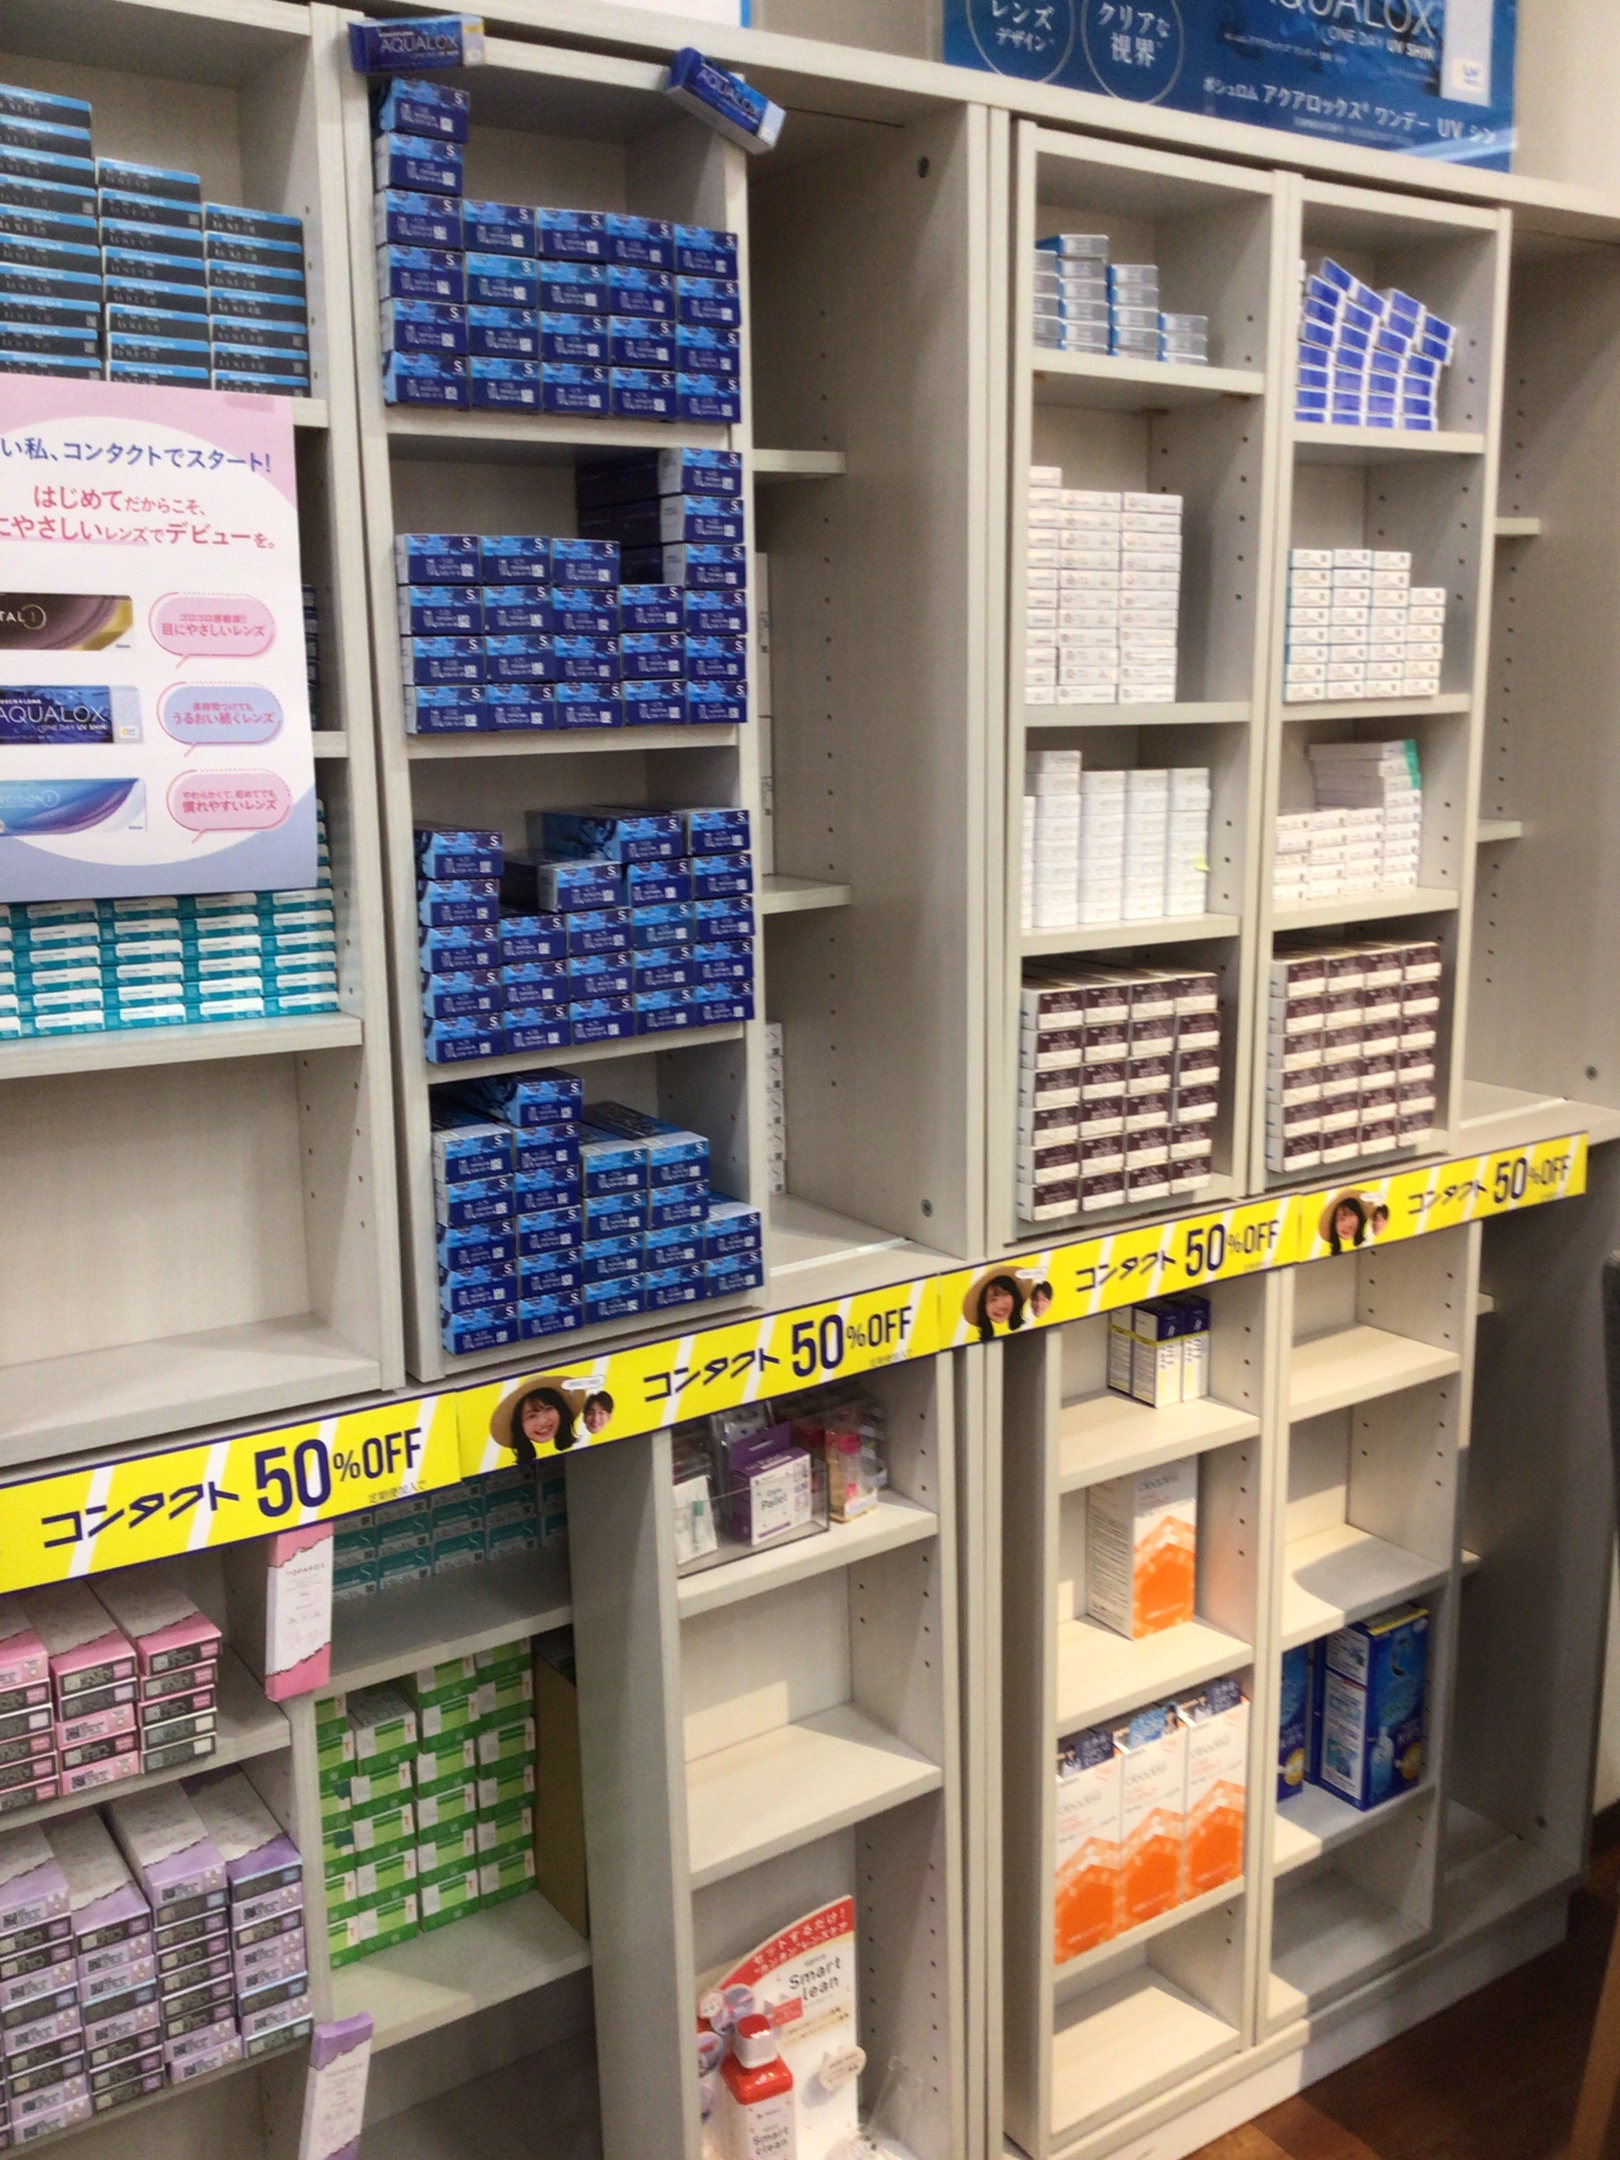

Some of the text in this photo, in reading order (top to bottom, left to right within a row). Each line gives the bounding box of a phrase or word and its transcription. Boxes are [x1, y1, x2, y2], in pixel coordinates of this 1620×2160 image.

[1099, 2, 1171, 38] クリアな
[380, 34, 459, 53] AQUALOX
[995, 27, 1047, 52] デザイン
[1110, 32, 1155, 69] 視界
[454, 92, 463, 105] S
[1203, 76, 1259, 101] ボシュロム
[1374, 106, 1432, 132] ワンデー
[1437, 117, 1464, 140] UV
[1469, 124, 1498, 145] シン
[446, 144, 455, 157] S
[443, 199, 453, 212] S
[519, 208, 528, 220] S
[591, 215, 600, 227] S
[660, 223, 669, 236] S
[726, 235, 735, 250] S
[445, 254, 455, 266] S
[522, 260, 531, 273] S
[591, 266, 600, 278] S
[660, 274, 669, 286] S
[726, 282, 735, 295] S
[450, 307, 459, 319] S
[522, 311, 532, 323] S
[593, 317, 602, 330] S
[660, 322, 670, 334] S
[728, 333, 736, 344] S
[454, 360, 463, 373] S
[524, 362, 533, 375] S
[594, 367, 603, 379] S
[661, 373, 671, 385] S
[728, 379, 737, 391] S
[33, 484, 206, 516] はじめてだからこそ、
[731, 500, 739, 512] S
[462, 537, 472, 549] S
[534, 537, 544, 550] S
[605, 543, 614, 555] S
[733, 546, 741, 558] S
[466, 589, 476, 601] S
[537, 586, 546, 598] S
[669, 586, 678, 597] S
[605, 594, 614, 605] S
[734, 593, 742, 603] S
[162, 622, 266, 637] 目にやさしいレンズ
[469, 638, 478, 650] S
[539, 635, 548, 647] S
[670, 634, 679, 646] S
[735, 640, 743, 652] S
[607, 641, 616, 652] S
[471, 688, 481, 699] S
[543, 687, 551, 698] S
[611, 686, 620, 697] S
[672, 682, 681, 693] S
[736, 684, 744, 695] S
[0, 704, 108, 725] AQUALOX
[737, 811, 745, 822] S
[668, 819, 677, 829] S
[490, 835, 499, 847] S
[739, 855, 747, 865] S
[607, 865, 616, 876] S
[679, 862, 687, 873] S
[485, 882, 494, 894] S
[679, 904, 688, 915] S
[740, 898, 749, 909] S
[617, 910, 626, 921] S
[552, 917, 561, 928] S
[485, 928, 493, 939] S
[681, 946, 690, 957] S
[618, 954, 627, 966] S
[555, 962, 563, 973] S
[487, 972, 495, 983] S
[682, 989, 691, 1000] S
[621, 998, 630, 1009] S
[555, 1006, 564, 1017] S
[489, 1016, 498, 1027] S
[570, 1082, 579, 1093] S
[566, 1124, 575, 1135] S
[494, 1135, 503, 1145] S
[566, 1168, 575, 1179] S
[499, 1178, 508, 1188] S
[696, 1183, 704, 1194] S
[633, 1193, 642, 1205] S
[1408, 1178, 1488, 1215] コンタクト
[502, 1221, 511, 1232] S
[630, 1235, 638, 1247] S
[569, 1250, 577, 1261] S
[750, 1251, 758, 1263] S
[1076, 1219, 1280, 1293] コンタクト 50%OFF
[504, 1263, 513, 1274] S
[691, 1265, 700, 1275] S
[570, 1293, 579, 1304] S
[505, 1306, 514, 1317] S
[643, 1306, 913, 1403] コンタクト 50%OFF
[41, 1426, 422, 1549] コンタクト 50%OFF
[788, 1956, 841, 1990] Smart
